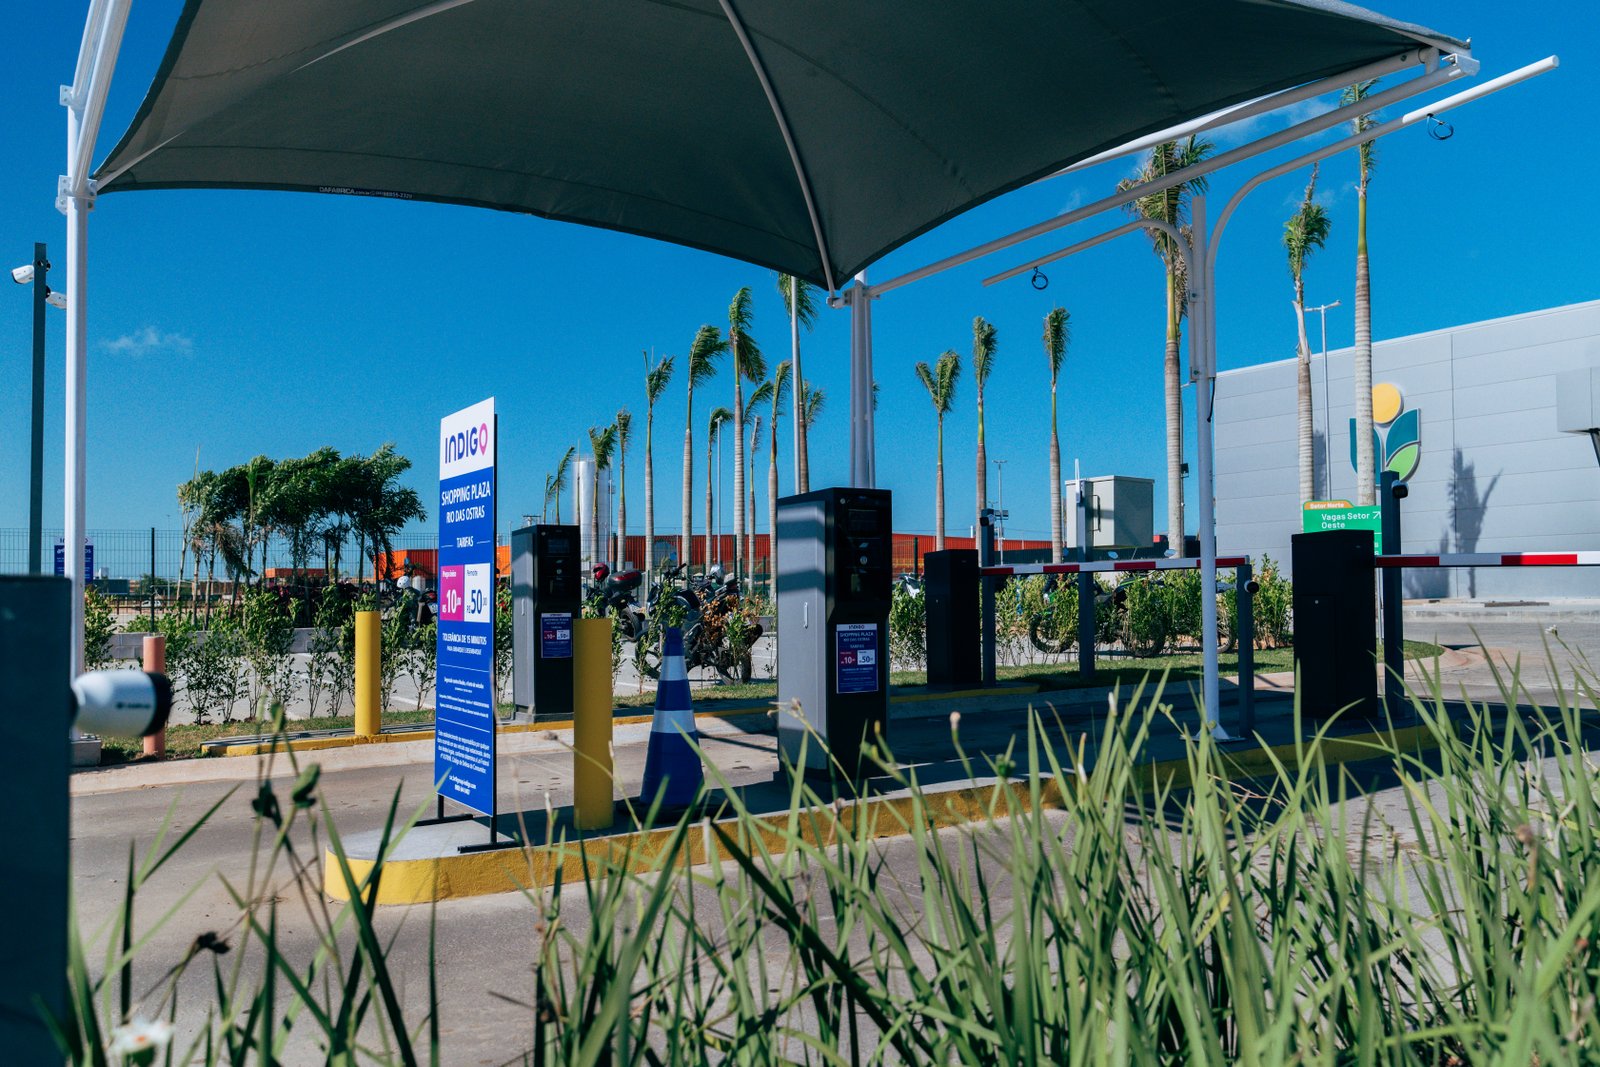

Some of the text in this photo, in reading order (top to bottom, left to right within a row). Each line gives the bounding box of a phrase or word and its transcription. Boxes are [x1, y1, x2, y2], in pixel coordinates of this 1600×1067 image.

[444, 422, 489, 464] INDIGO
[441, 481, 491, 506] SHOPPING PLAZA
[446, 505, 485, 524] RIO DAS OSTRAS
[1321, 512, 1370, 522] Vagas Setor
[1321, 521, 1346, 529] Oeste
[456, 536, 474, 548] TARIFAS
[442, 632, 462, 643] TOLERÂNCIA
[471, 635, 487, 646] MINUTOS
